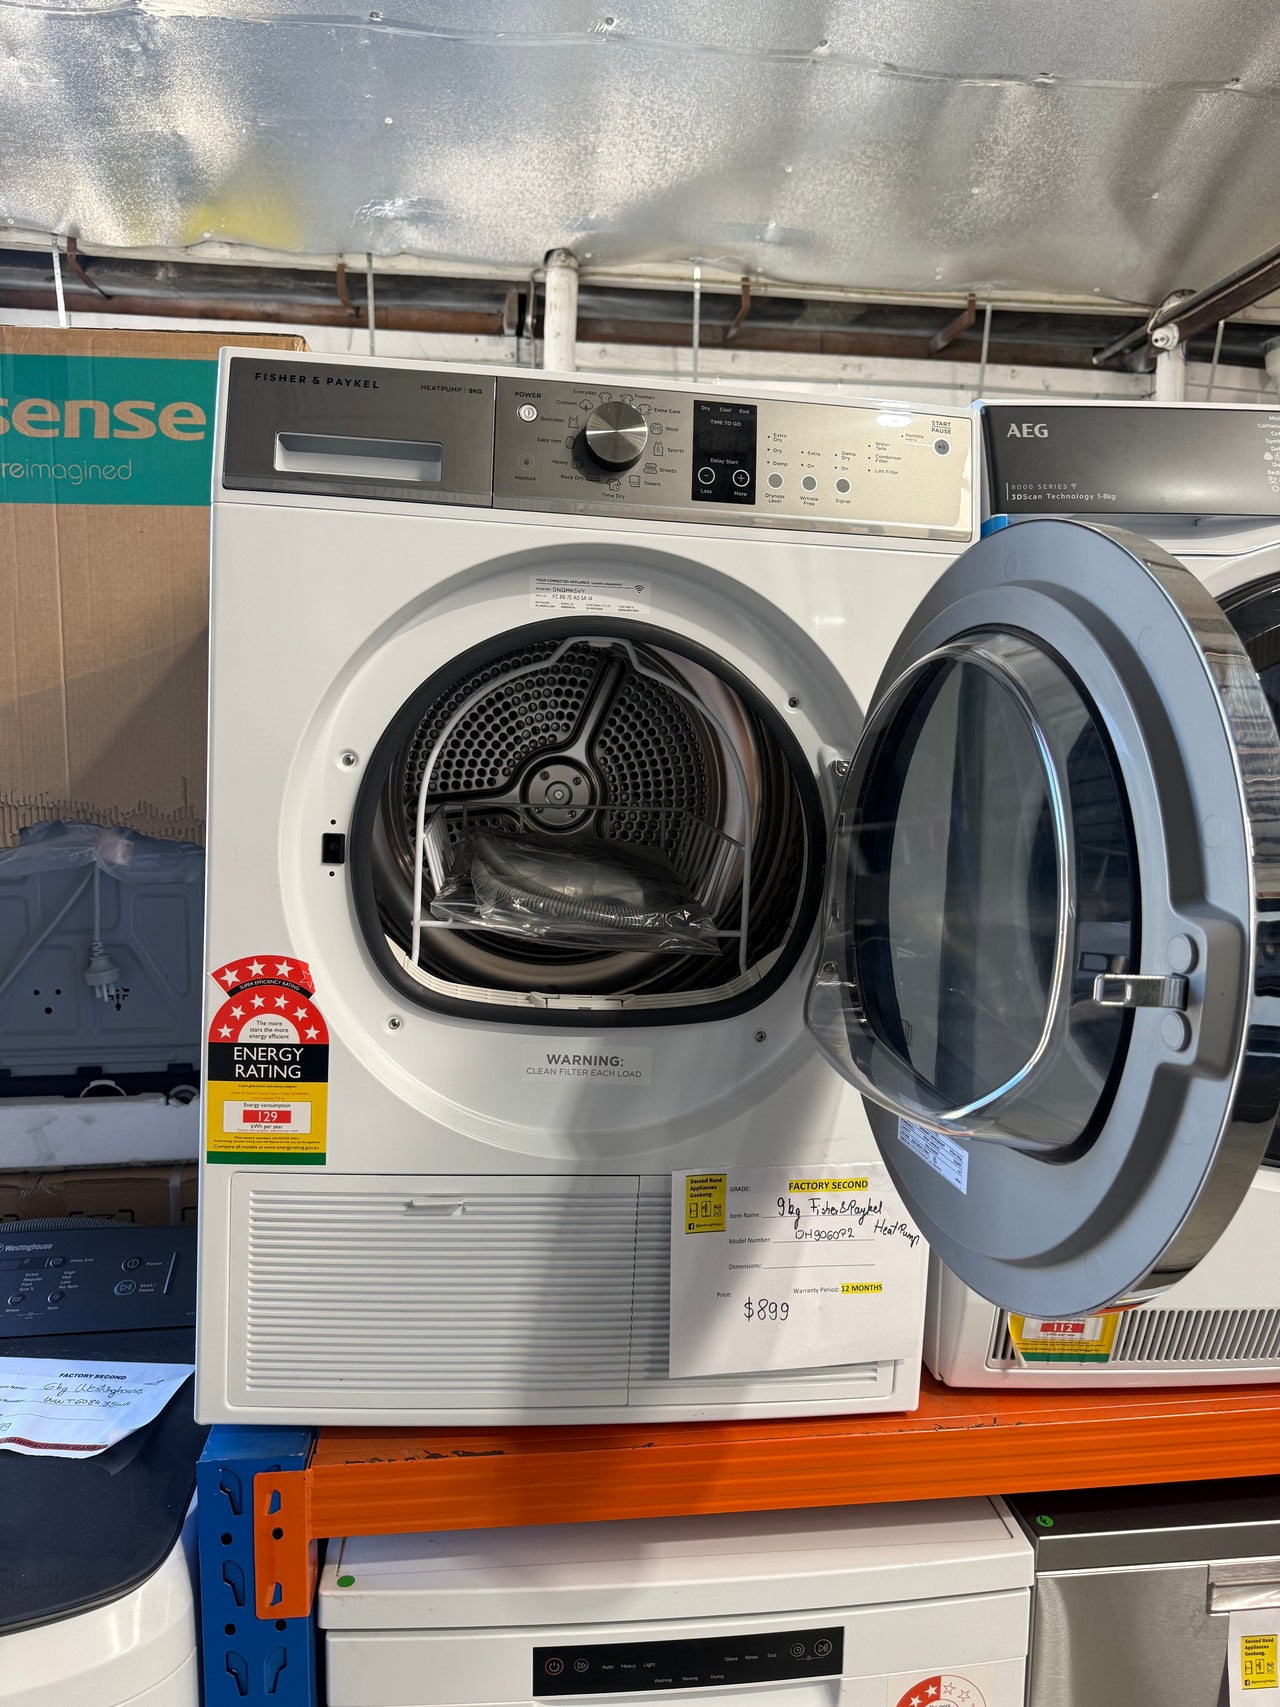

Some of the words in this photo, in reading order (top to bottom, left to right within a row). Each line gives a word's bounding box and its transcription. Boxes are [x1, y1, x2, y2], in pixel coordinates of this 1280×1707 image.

[255, 372, 307, 384] FISHER
[312, 376, 321, 385] &
[326, 377, 379, 389] PAYKEL
[421, 384, 462, 393] HEATPUMP
[468, 387, 483, 395] 9KG
[573, 389, 597, 397] Everyday
[514, 391, 542, 399] POWER
[635, 393, 656, 401] Freshen
[669, 407, 681, 415] Care
[541, 416, 565, 424] Delicates
[931, 420, 951, 428] START
[931, 428, 952, 436] PAUSE
[1006, 423, 1049, 439] AEG
[538, 437, 549, 445] Easy
[668, 447, 685, 455] Sports
[552, 459, 568, 467] Heavy
[1, 459, 133, 485] reimagined
[1011, 493, 1043, 501] 3DScan
[1046, 493, 1094, 502] Technology
[1097, 493, 1116, 502] 1-8kg
[239, 981, 254, 990] SUPER
[281, 981, 300, 991] RATING
[234, 1047, 304, 1062] ENERGY
[546, 1054, 624, 1067] WARNING:
[235, 1064, 301, 1079] RATING
[526, 1067, 557, 1075] CLEAN
[560, 1068, 588, 1076] FILTER
[591, 1069, 615, 1077] EACH
[618, 1070, 642, 1078] LOAD
[258, 1111, 278, 1122] 129
[789, 1181, 829, 1190] FACTORY
[831, 1180, 869, 1190] SECOND
[874, 1219, 898, 1235] Heat
[5, 1244, 53, 1252] Westinghouse
[851, 1284, 883, 1292] MONTHS
[743, 1296, 790, 1322] $899
[1054, 1324, 1072, 1332] 112
